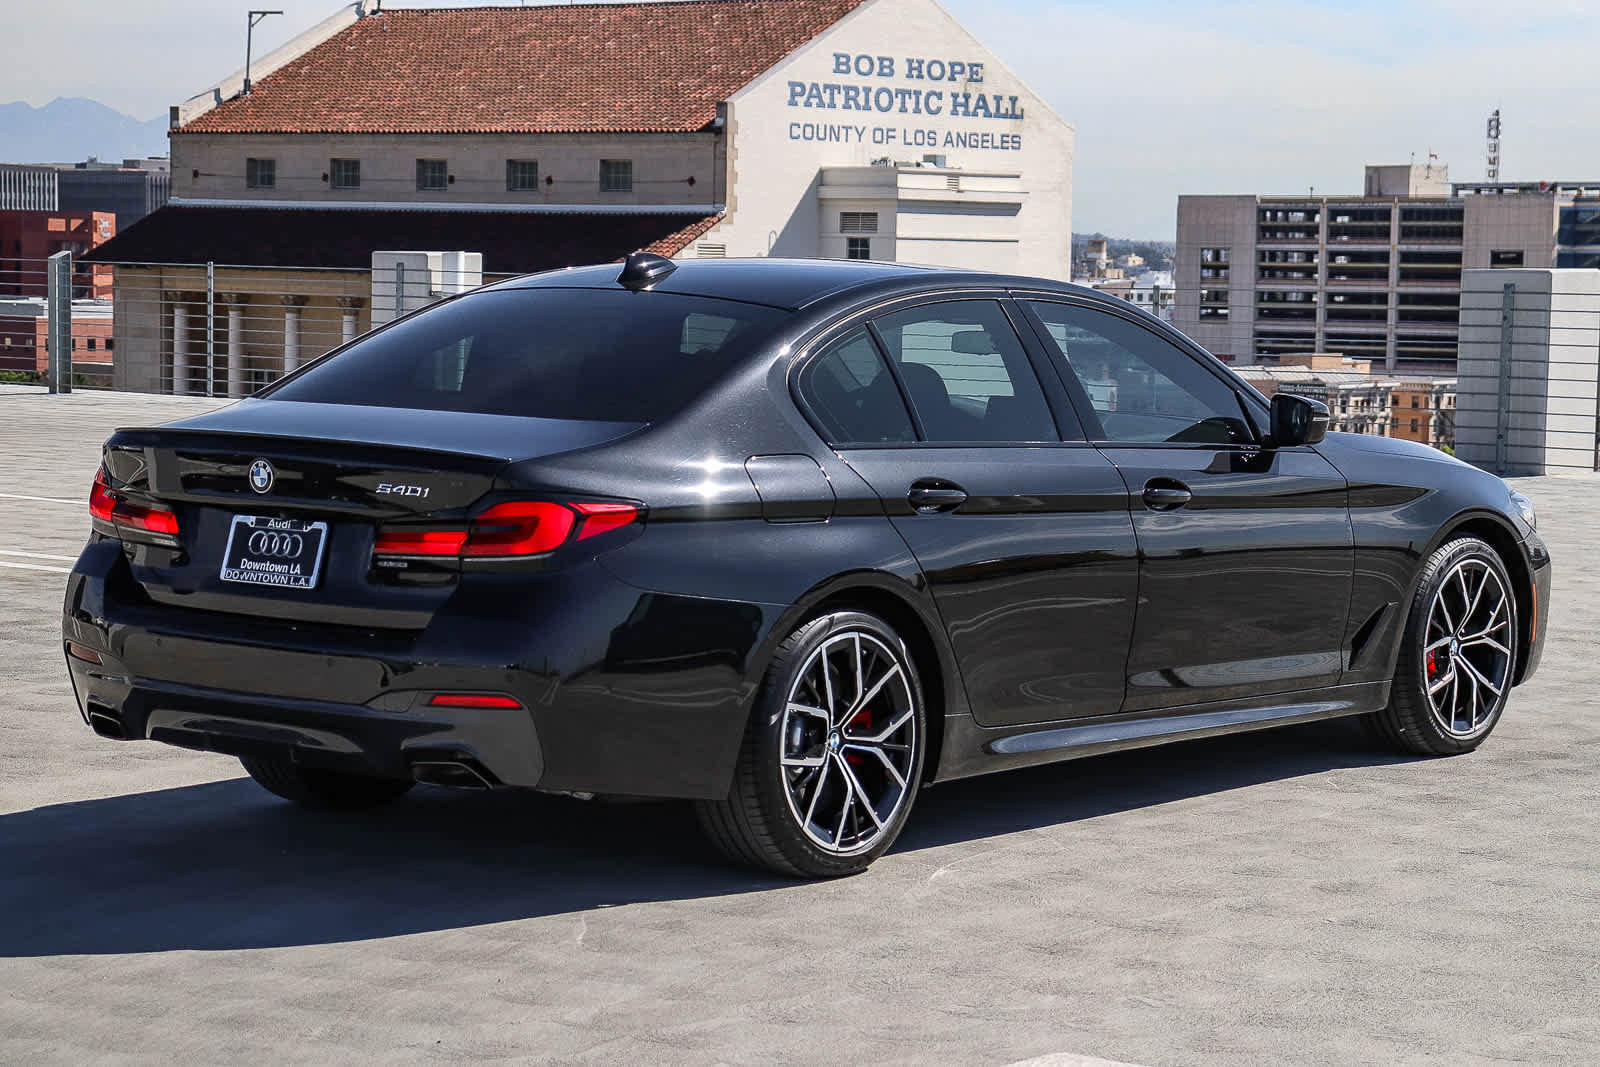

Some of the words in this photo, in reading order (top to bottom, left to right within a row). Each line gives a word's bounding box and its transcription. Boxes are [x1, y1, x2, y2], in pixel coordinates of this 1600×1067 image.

[833, 52, 895, 78] BOB
[905, 58, 984, 83] HOPE
[787, 81, 943, 115] PATRIOTIC
[950, 92, 1024, 120] HALL
[789, 123, 866, 143] COUNTY
[872, 128, 897, 145] OF
[903, 129, 937, 147] LOS
[943, 132, 1022, 150] ANGELES
[267, 518, 291, 529] Audi
[240, 558, 288, 573] Downtown
[289, 563, 301, 575] LA
[225, 570, 287, 585] DOWNTOWN
[290, 577, 308, 587] L.A.
